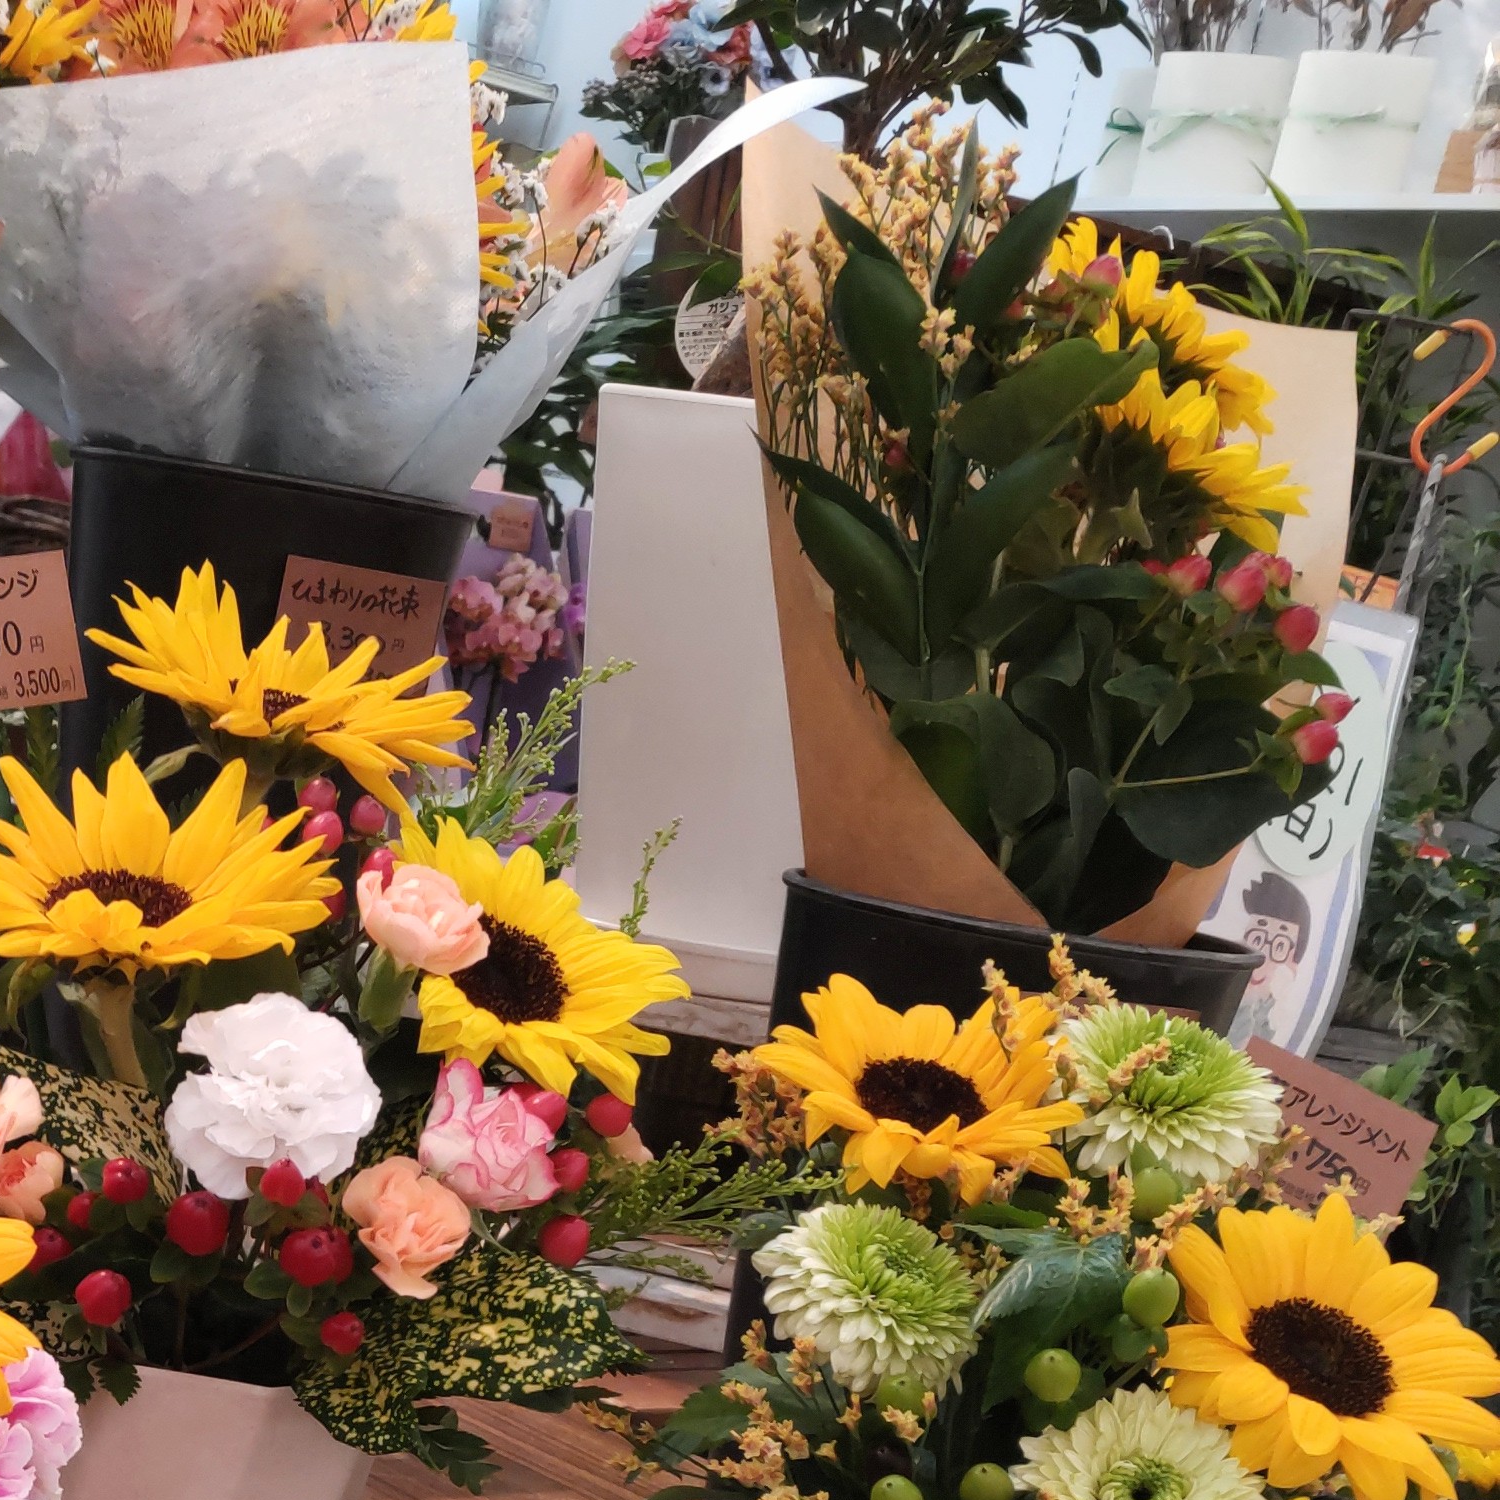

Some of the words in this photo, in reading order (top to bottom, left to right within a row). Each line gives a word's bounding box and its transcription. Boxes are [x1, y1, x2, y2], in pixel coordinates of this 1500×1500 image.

[707, 301, 746, 315] ガジュ
[291, 577, 421, 621] ひまわりの花束
